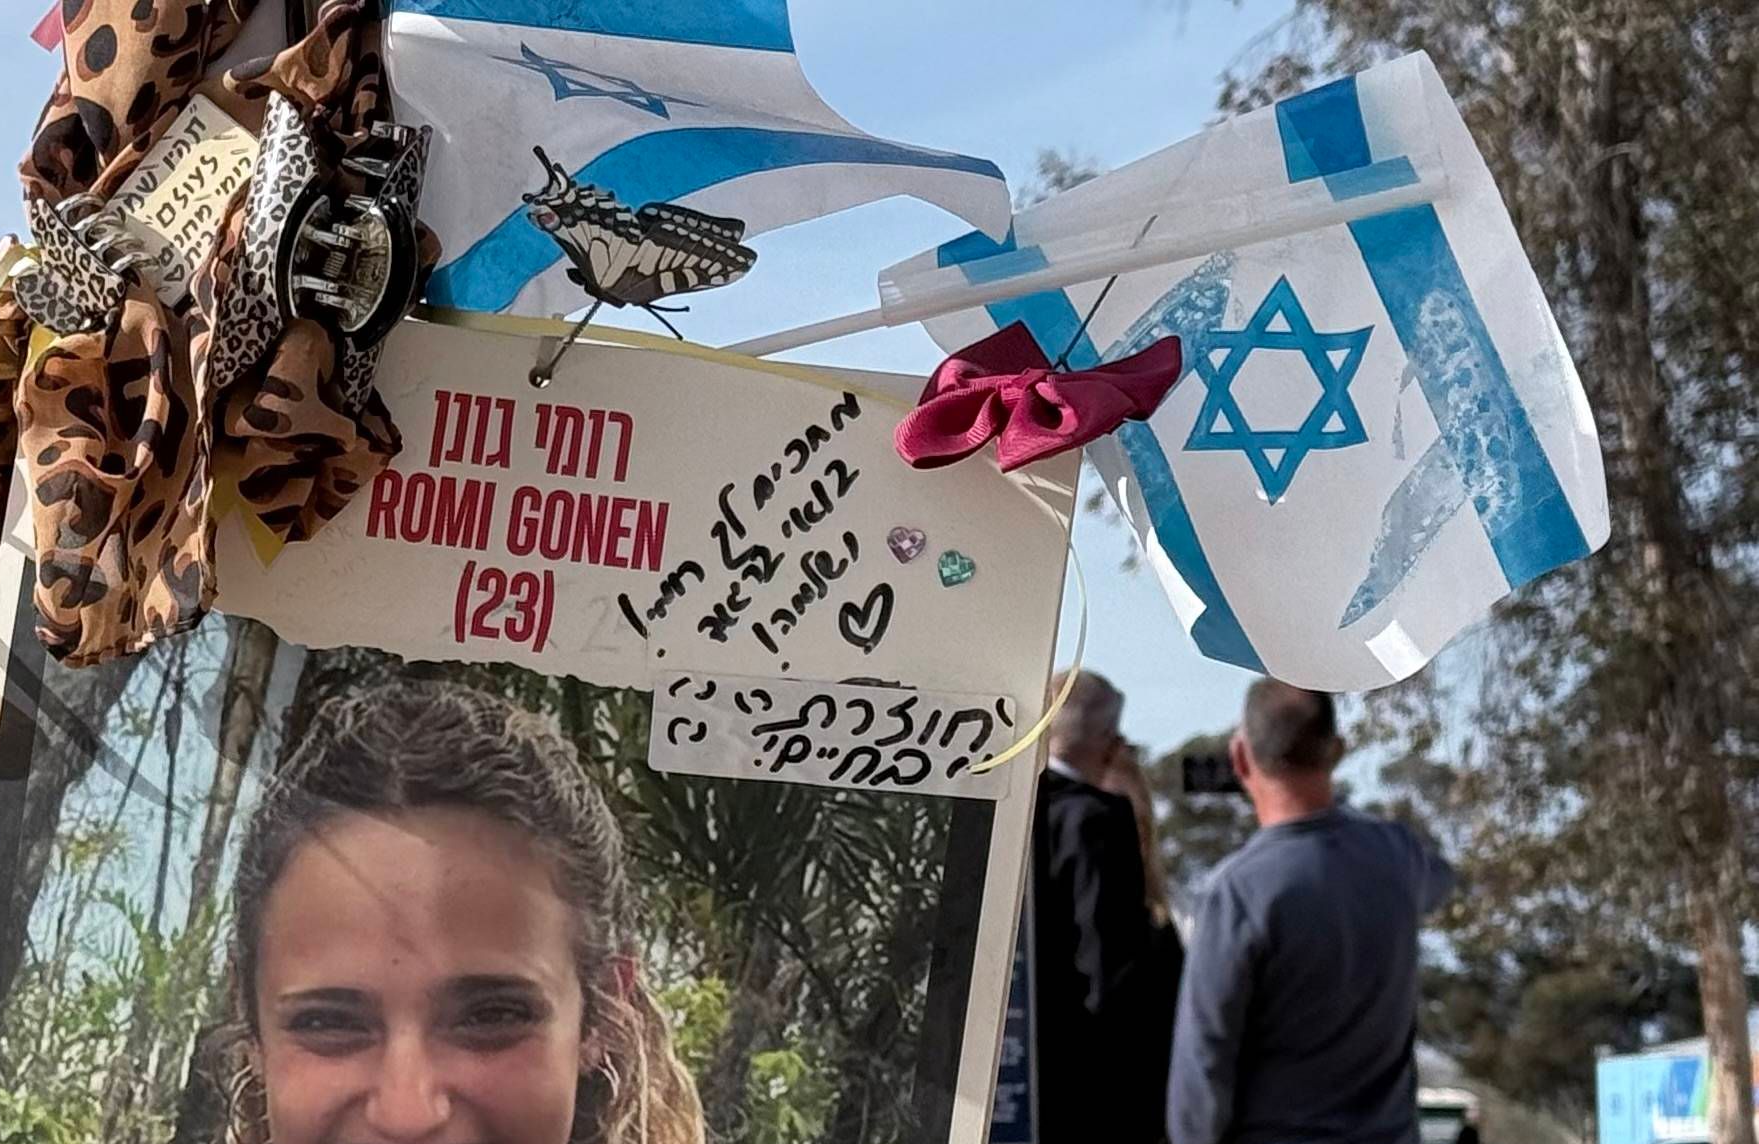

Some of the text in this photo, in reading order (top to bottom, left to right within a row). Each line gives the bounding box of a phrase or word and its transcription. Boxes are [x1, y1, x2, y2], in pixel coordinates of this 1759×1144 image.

[215, 156, 252, 197] רומי
[428, 390, 634, 483] רומי גונן
[366, 468, 671, 572] ROMI GONEN
[454, 560, 555, 653] (23)
